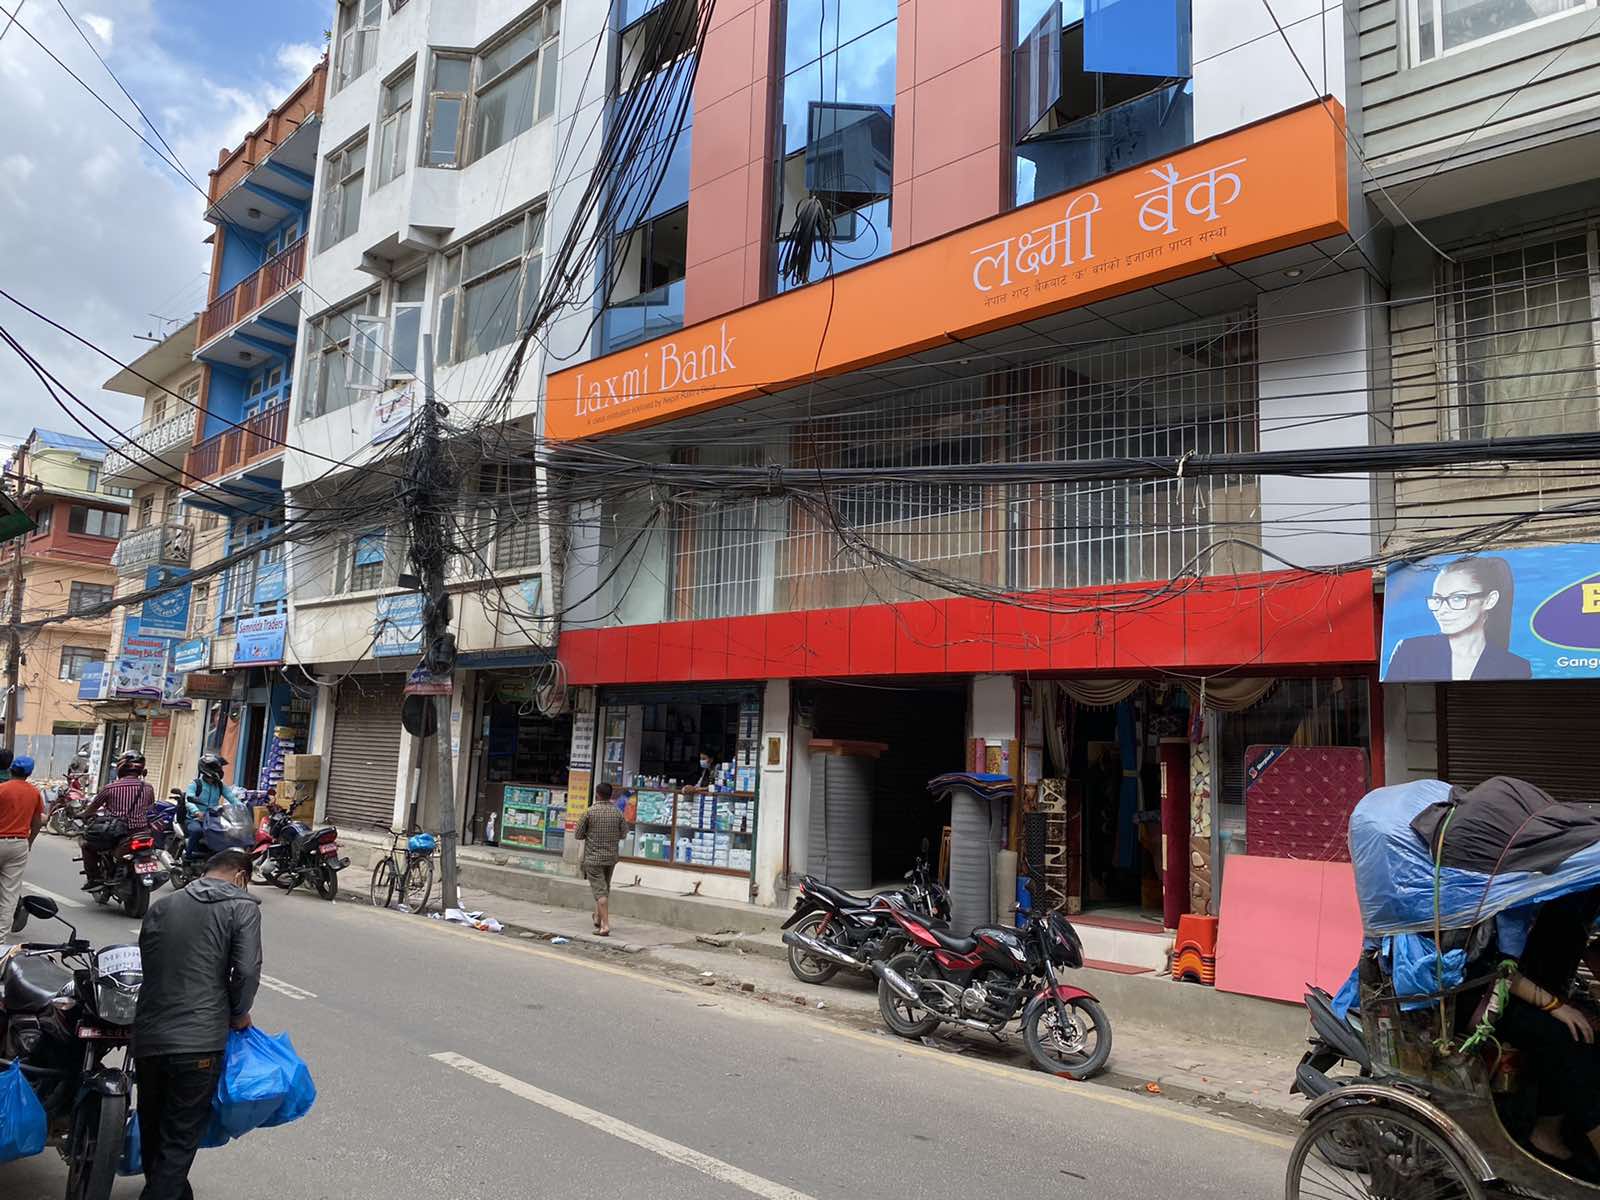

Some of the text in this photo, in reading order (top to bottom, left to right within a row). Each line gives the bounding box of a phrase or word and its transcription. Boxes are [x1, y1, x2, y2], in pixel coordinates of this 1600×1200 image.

[970, 158, 1248, 292] लक्ष्मी बैंक
[575, 321, 737, 418] Laxmi Bank
[1557, 656, 1600, 669] Gang
